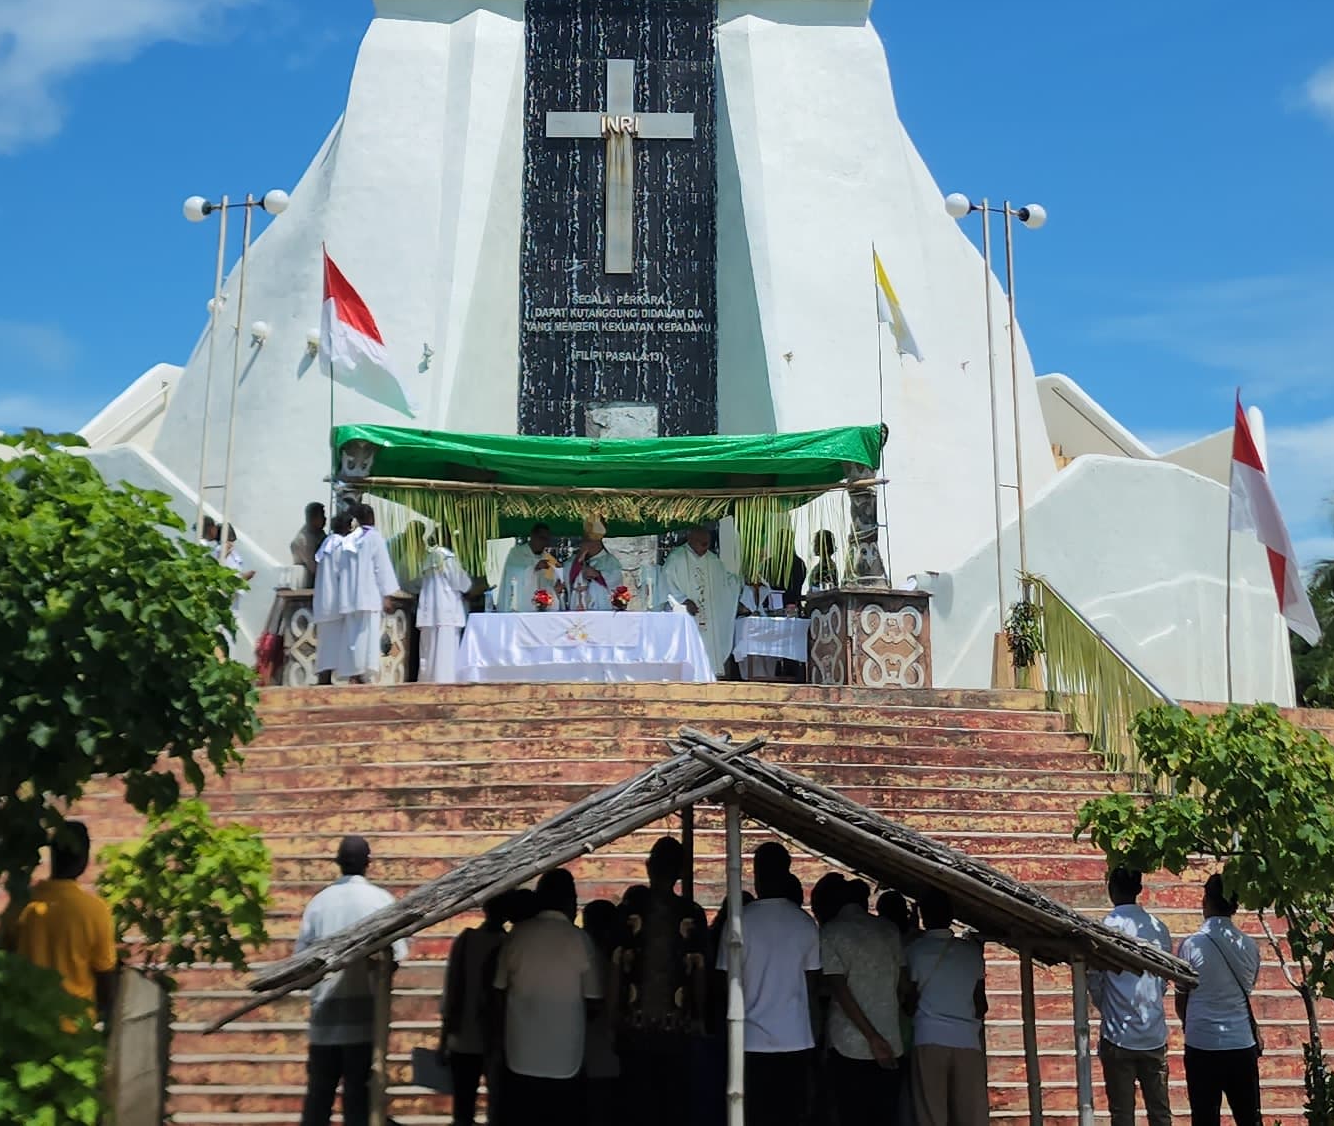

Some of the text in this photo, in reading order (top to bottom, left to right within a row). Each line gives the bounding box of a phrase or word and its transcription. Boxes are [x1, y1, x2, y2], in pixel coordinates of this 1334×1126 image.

[601, 115, 639, 134] INRI
[572, 294, 665, 305] SEGALA PERKARA
[535, 308, 704, 319] DAPAT KUTANGGUNG DIDALAM DIA
[526, 321, 711, 332] YANG MEMBERI KEKUATAN KEPADAKU
